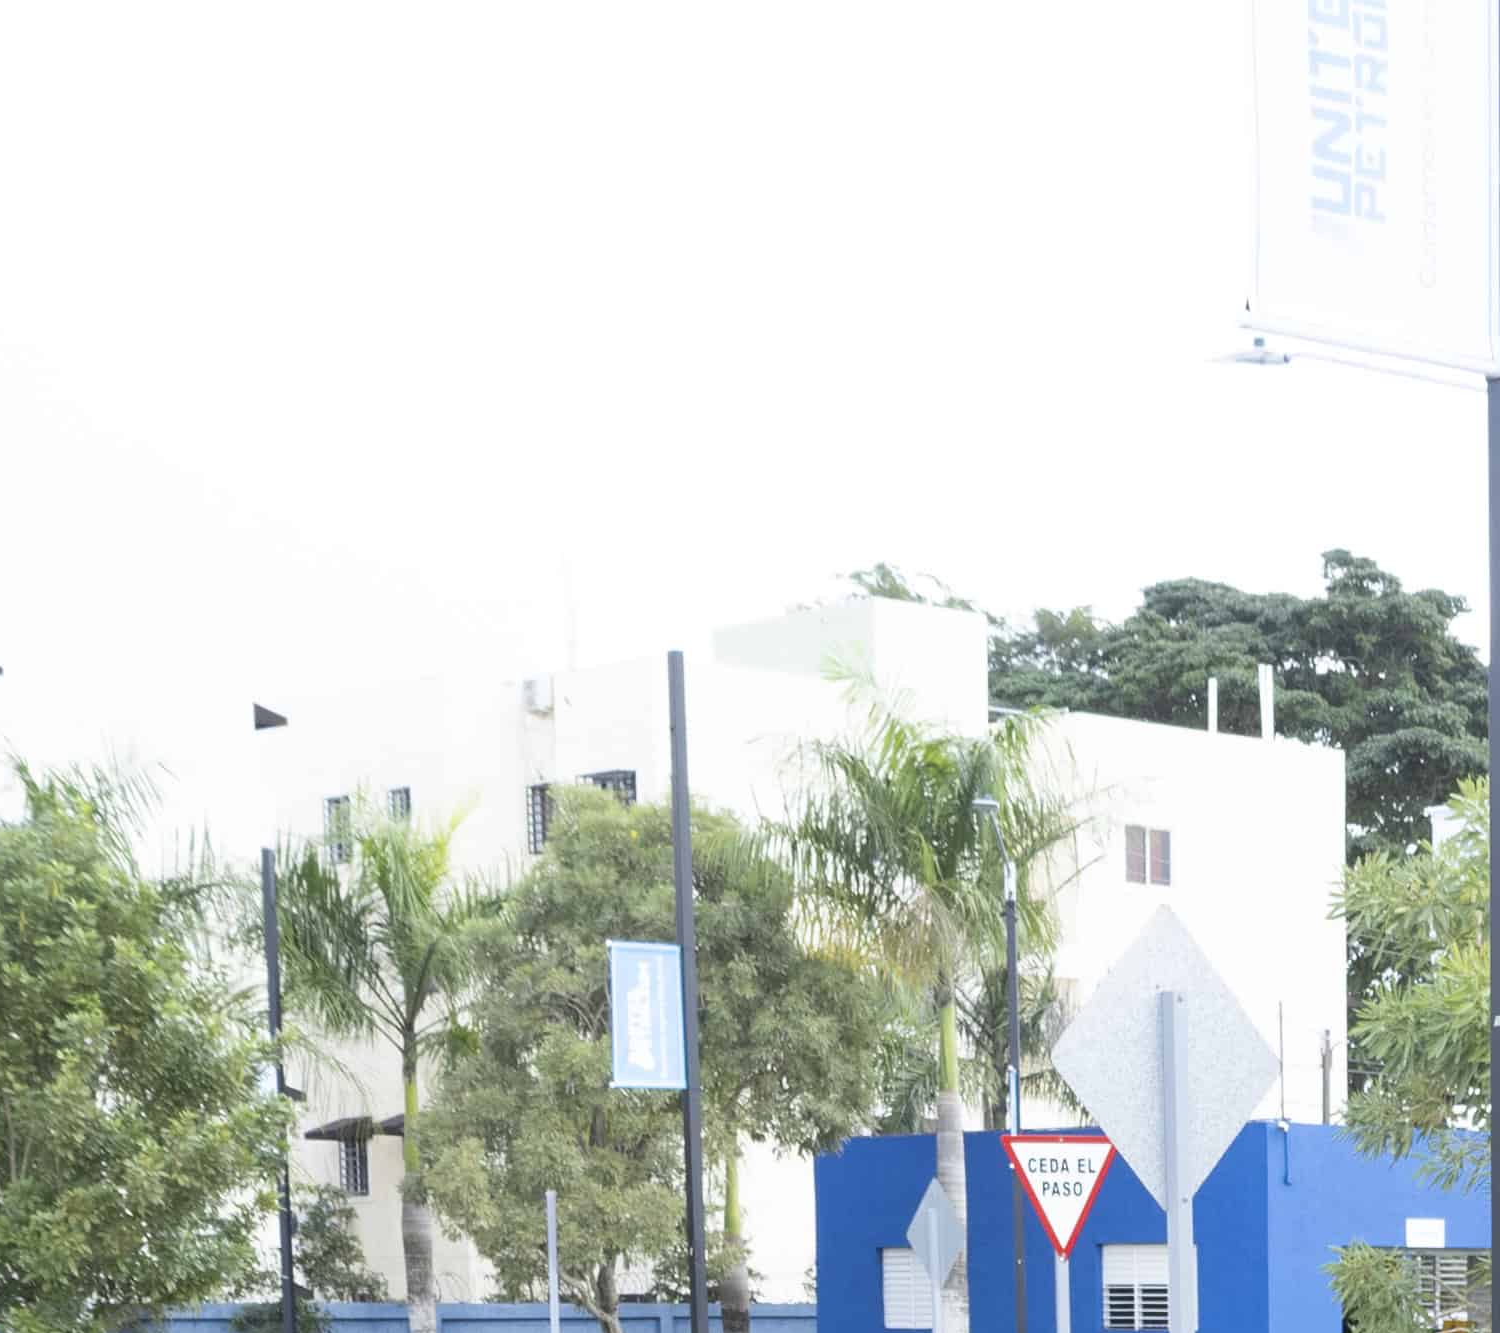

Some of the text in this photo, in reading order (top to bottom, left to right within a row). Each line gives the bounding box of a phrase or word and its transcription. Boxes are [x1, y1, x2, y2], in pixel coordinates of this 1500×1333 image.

[1027, 1157, 1096, 1174] CEDA EL
[1041, 1181, 1084, 1198] PASO
